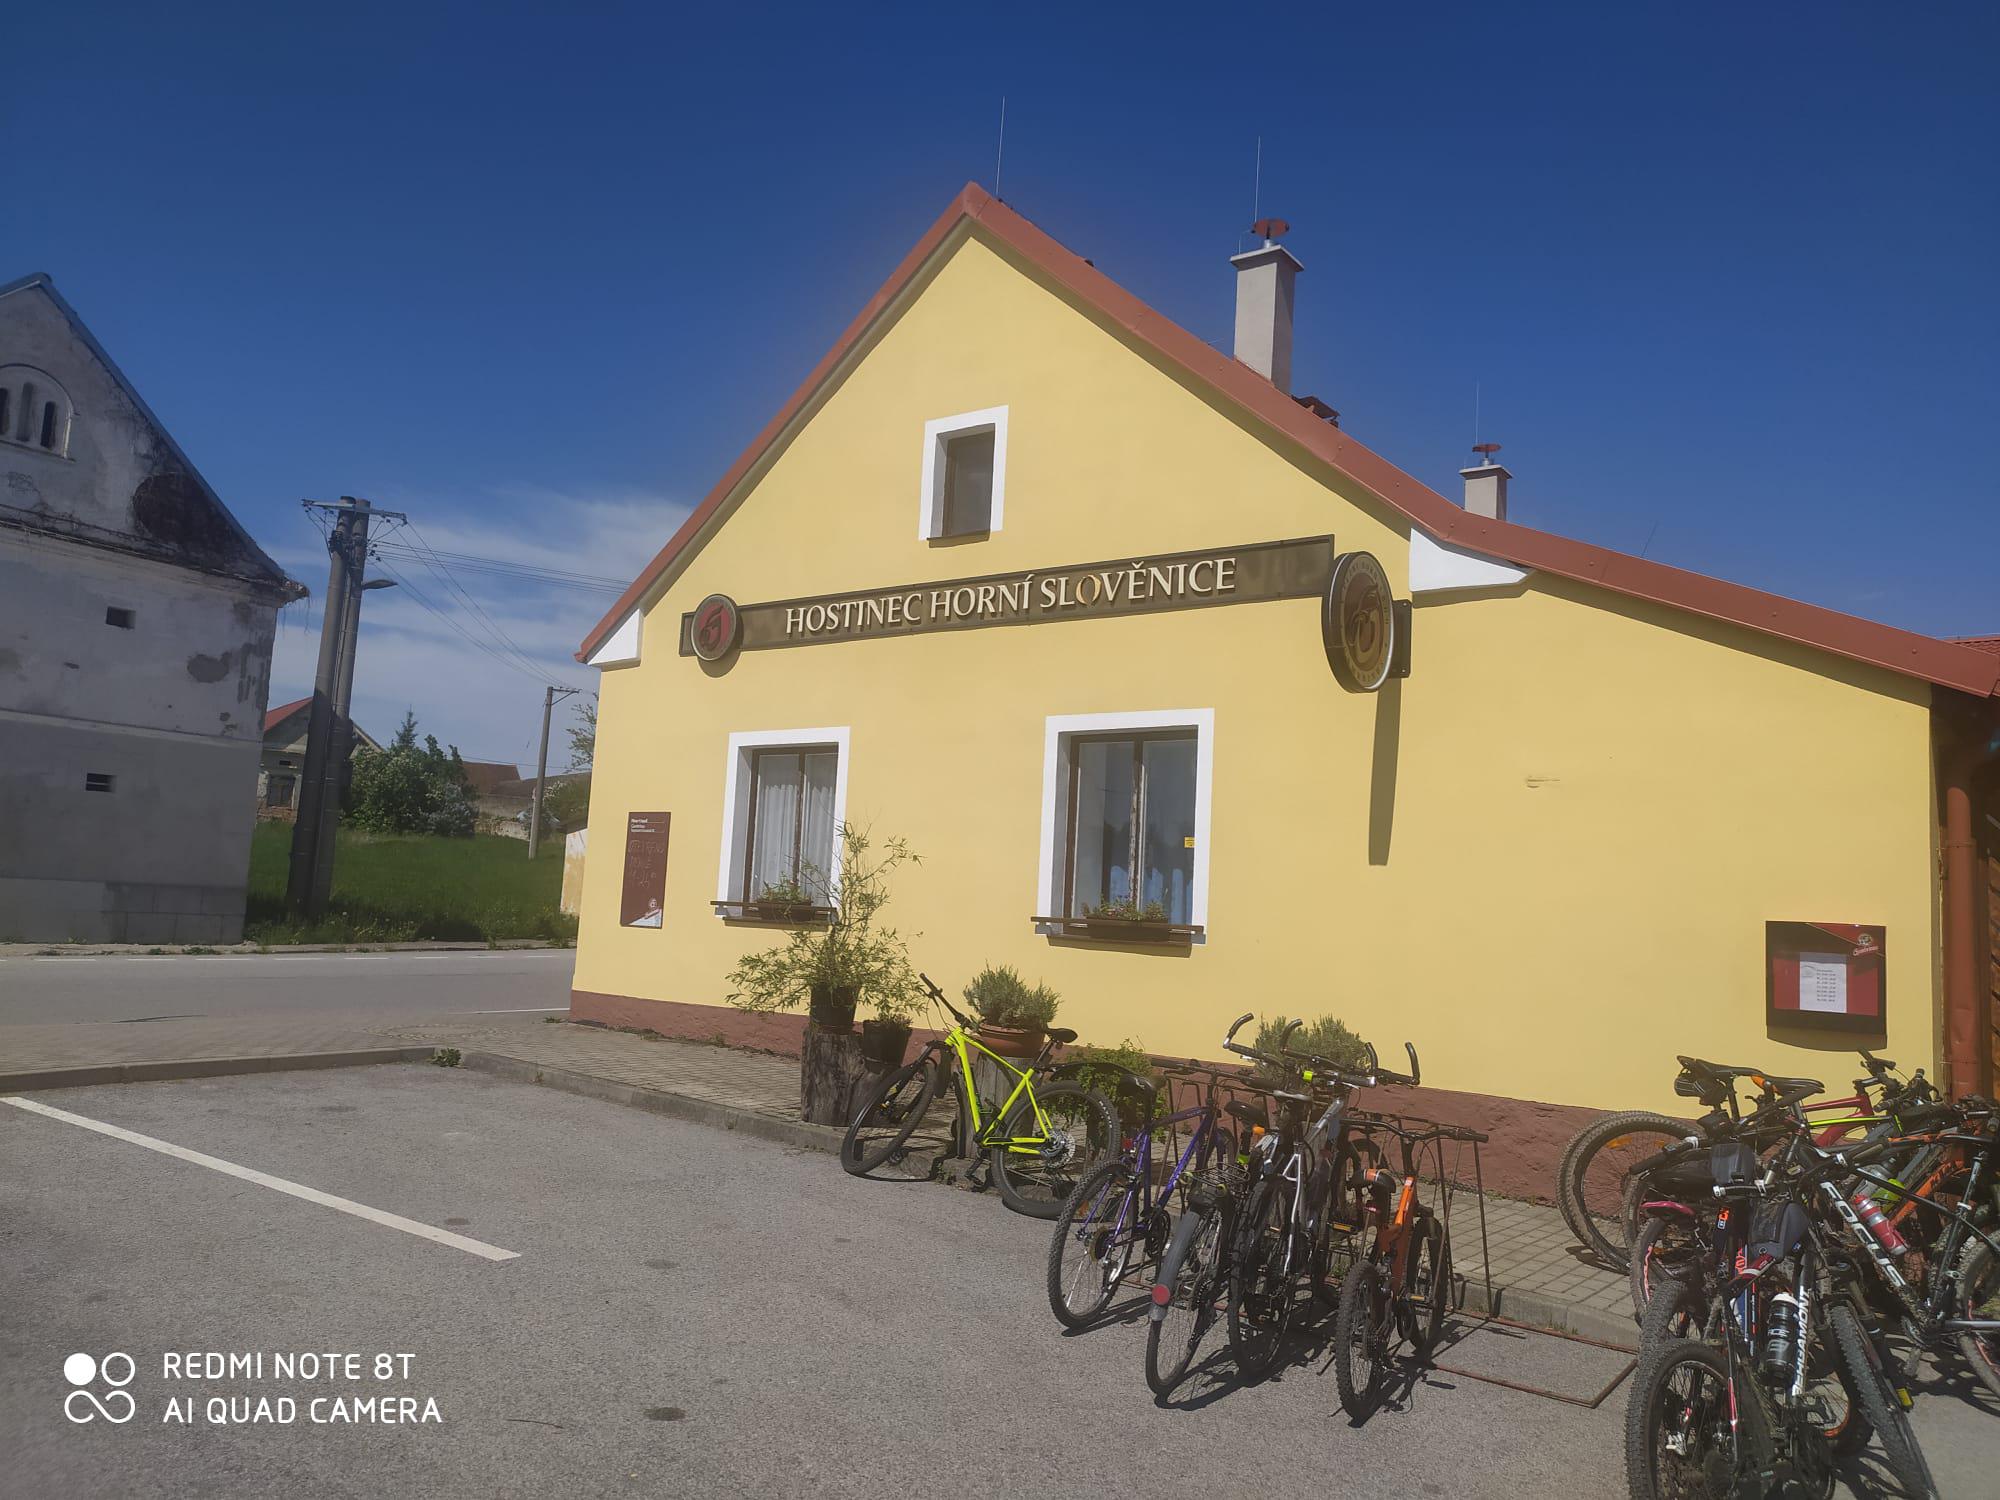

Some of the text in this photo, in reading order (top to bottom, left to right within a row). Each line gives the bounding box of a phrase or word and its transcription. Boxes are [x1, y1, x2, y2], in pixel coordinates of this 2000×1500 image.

[785, 557, 1237, 634] HOSTINEC HORNÍ SLOVĚNICE
[1820, 1181, 1906, 1287] FOCUS
